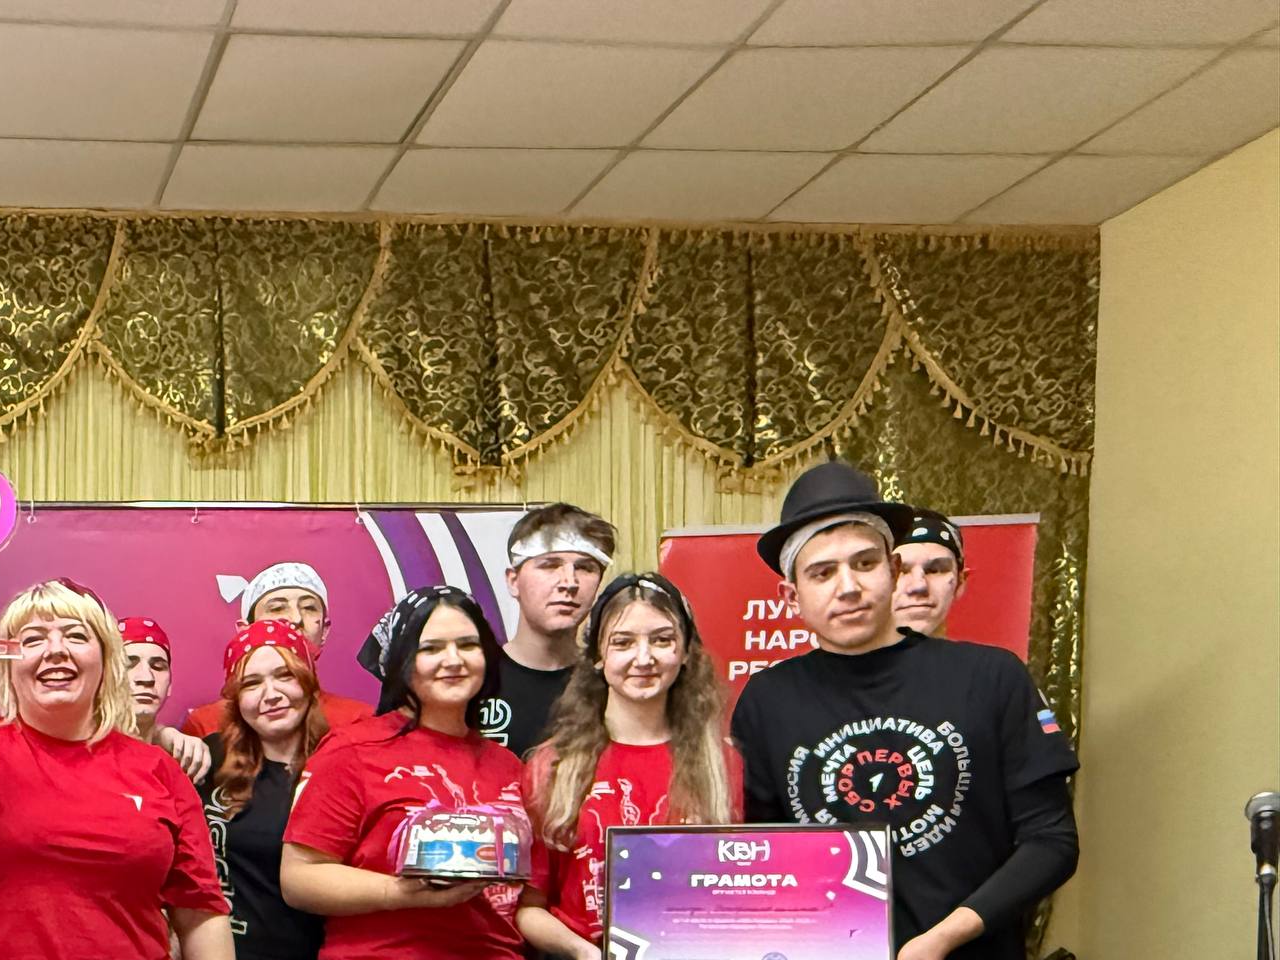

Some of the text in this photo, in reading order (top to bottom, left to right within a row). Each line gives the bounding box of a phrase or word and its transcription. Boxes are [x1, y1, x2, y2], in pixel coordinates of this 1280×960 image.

[728, 660, 784, 681] РЕ
[813, 717, 945, 758] ИНИЦИАТИВА
[787, 746, 810, 824] МИССИЯ
[821, 743, 857, 803] МЕЧТА
[838, 749, 914, 812] СБОР ПЕРВЫХ
[907, 745, 935, 800] ЦЕЛЬ
[718, 840, 770, 862] КВН
[900, 816, 957, 857] ИДЕЯ
[691, 874, 798, 887] ГРАМОТА
